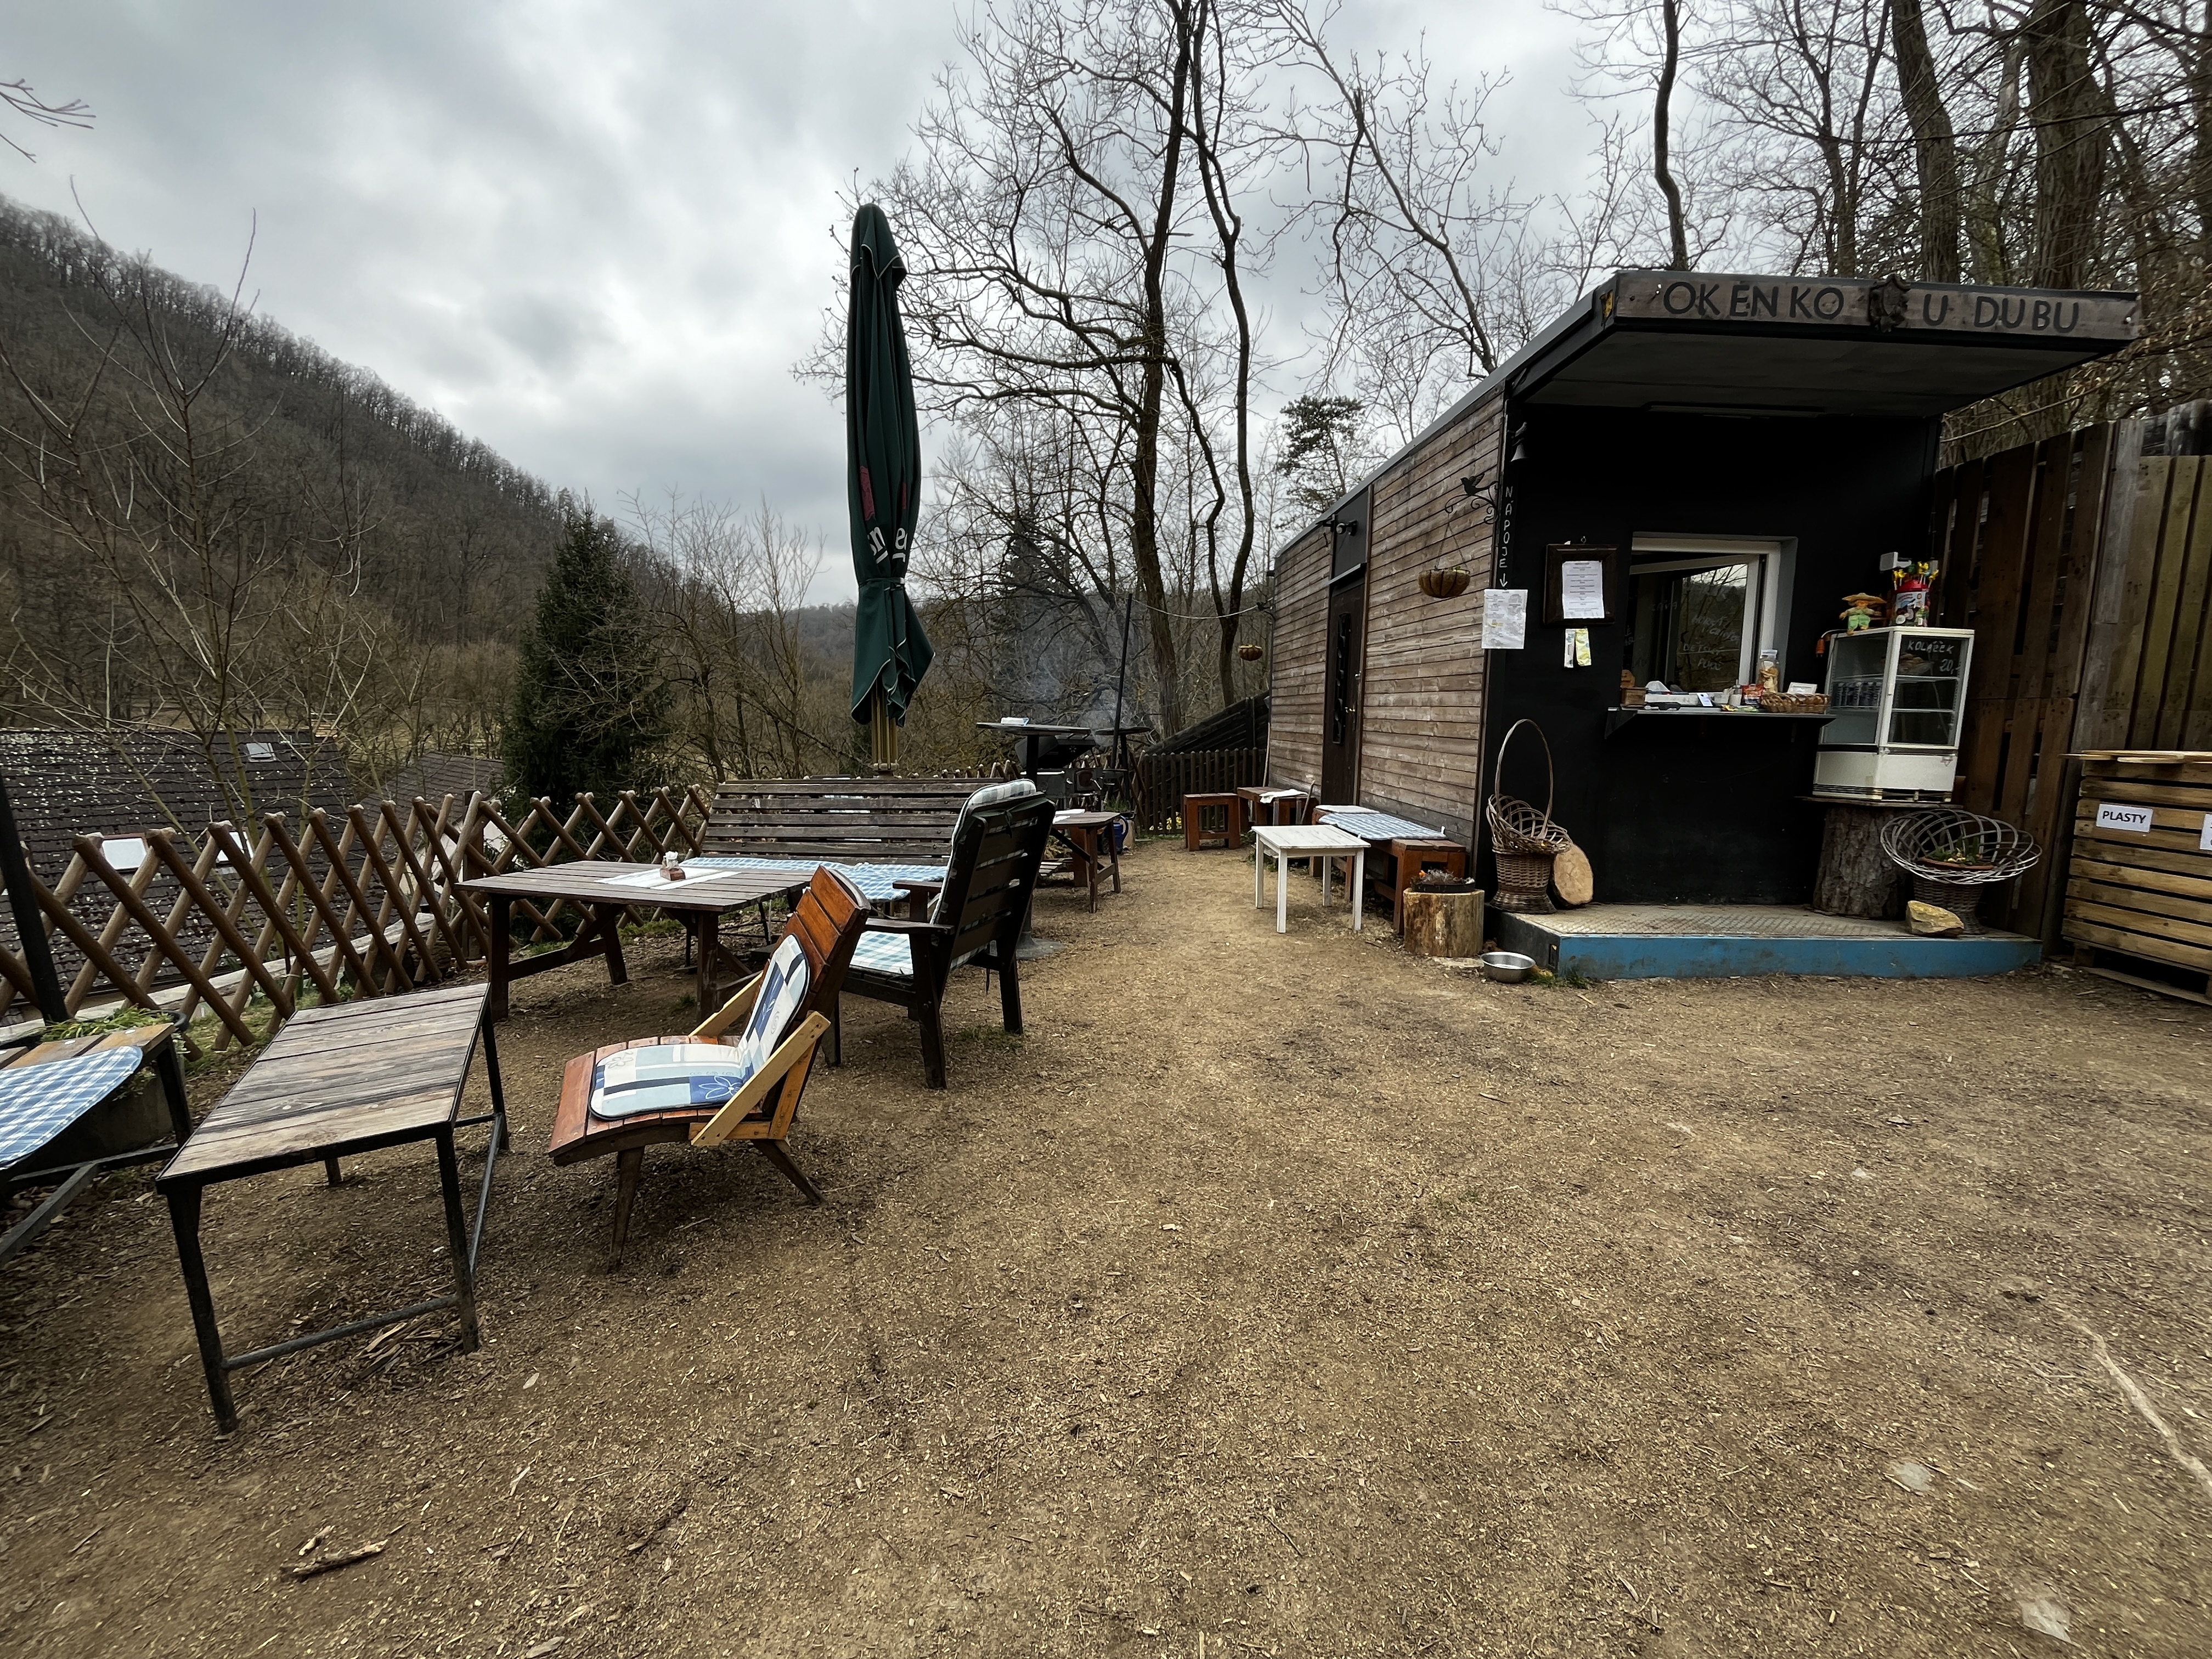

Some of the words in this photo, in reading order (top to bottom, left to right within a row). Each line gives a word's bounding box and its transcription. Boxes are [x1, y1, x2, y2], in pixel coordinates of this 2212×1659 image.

[1663, 281, 1844, 320] OKENKO
[1922, 294, 1949, 325] U
[1973, 295, 2080, 334] DUBU
[1499, 486, 1514, 568] NÁPOJE
[2102, 810, 2147, 824] PLASTY
